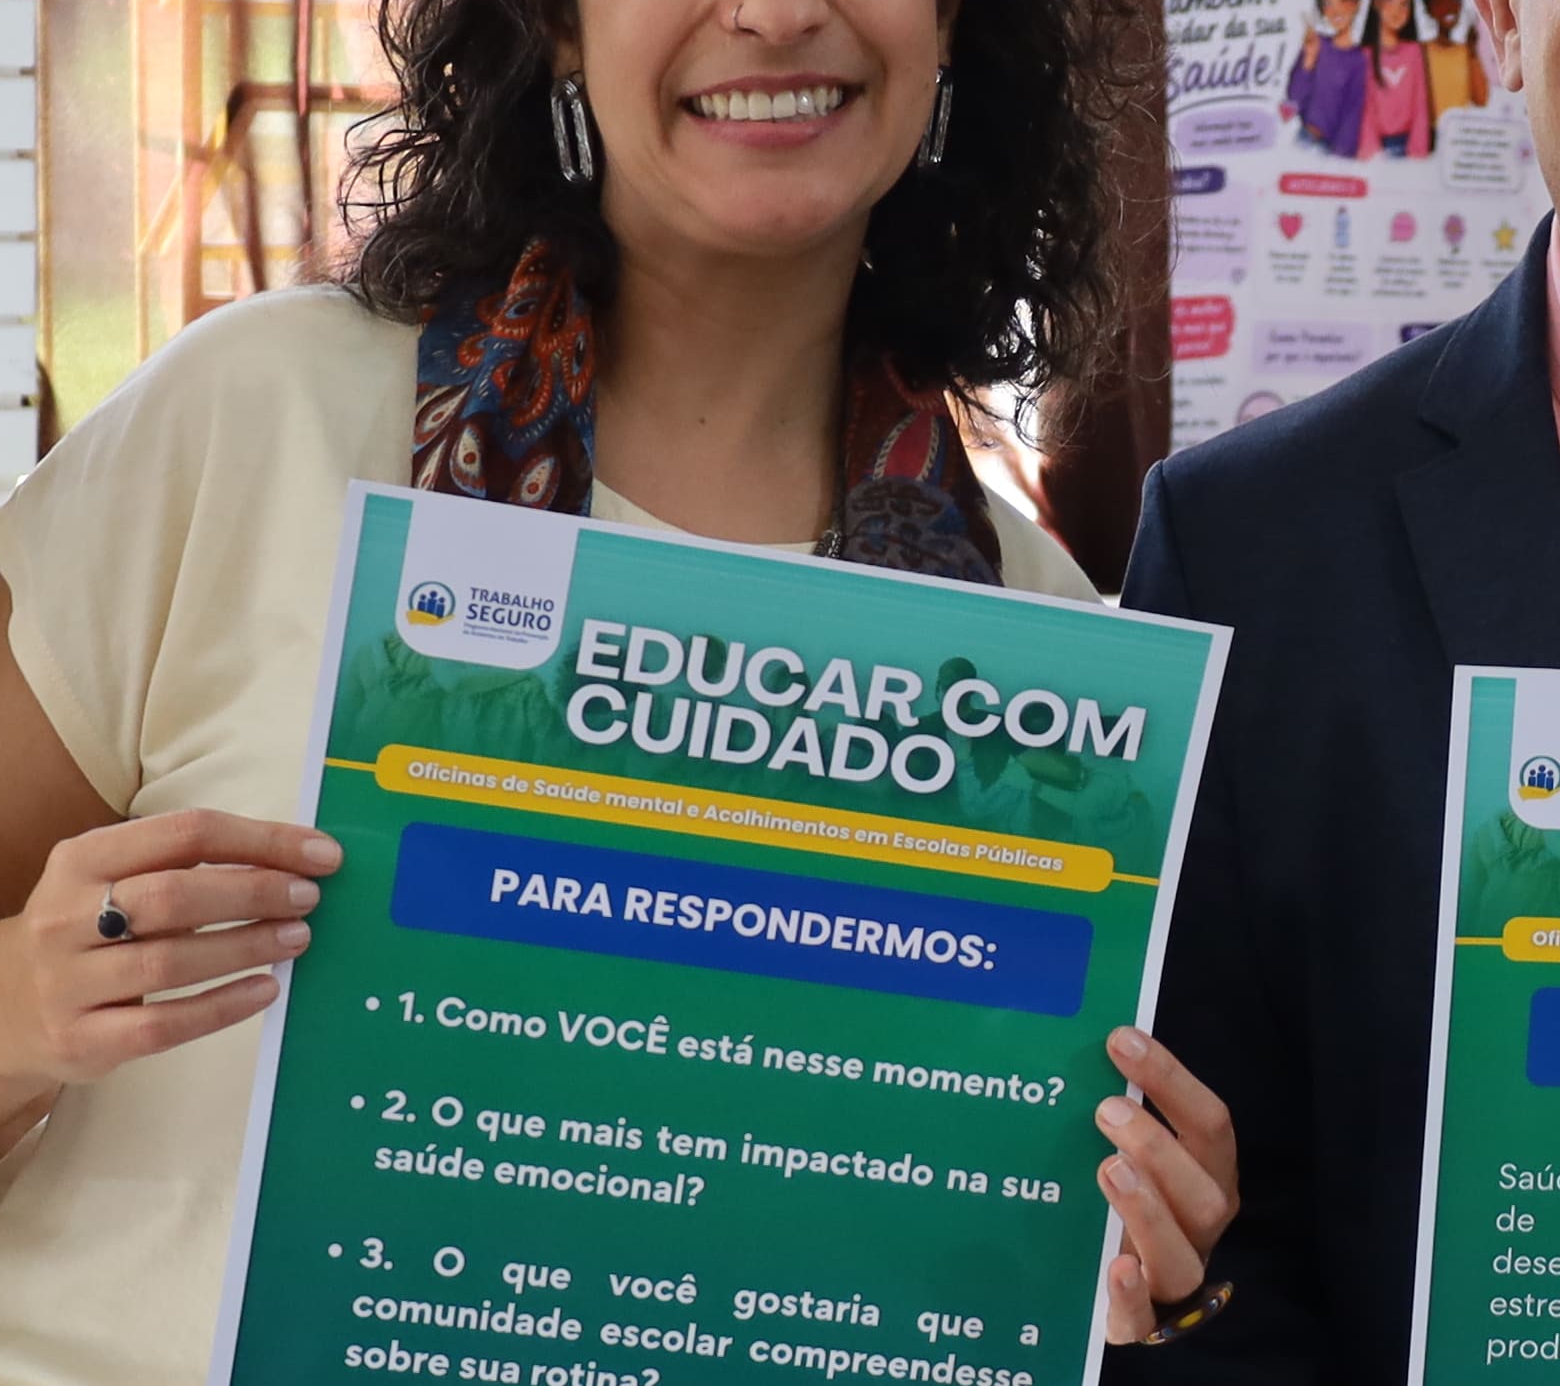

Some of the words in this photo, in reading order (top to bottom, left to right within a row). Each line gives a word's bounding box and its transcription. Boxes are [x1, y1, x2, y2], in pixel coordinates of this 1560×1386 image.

[466, 602, 552, 632] SEGURO
[470, 586, 555, 613] TRABALHO
[566, 683, 956, 794] CUIDADO
[575, 617, 923, 728] EDUCAR
[941, 678, 1147, 762] COM
[490, 868, 613, 918] PARA
[623, 886, 997, 971] RESPONDERMOS:
[398, 991, 425, 1024] 1.
[435, 996, 547, 1039] Como
[557, 1010, 671, 1055] VOCÊ
[676, 1034, 755, 1066] está
[762, 1046, 865, 1080] nesse
[872, 1061, 1066, 1107] momento?
[373, 1143, 485, 1181] saúde
[493, 1161, 705, 1207] emocional?
[380, 1089, 417, 1123] 2.
[431, 1095, 464, 1128] O
[475, 1109, 546, 1143] que
[558, 1116, 643, 1151] mais
[656, 1125, 728, 1161] tem
[740, 1132, 934, 1187] impactado
[946, 1168, 989, 1194] na
[1001, 1176, 1061, 1204] sua
[1495, 1204, 1535, 1233] de
